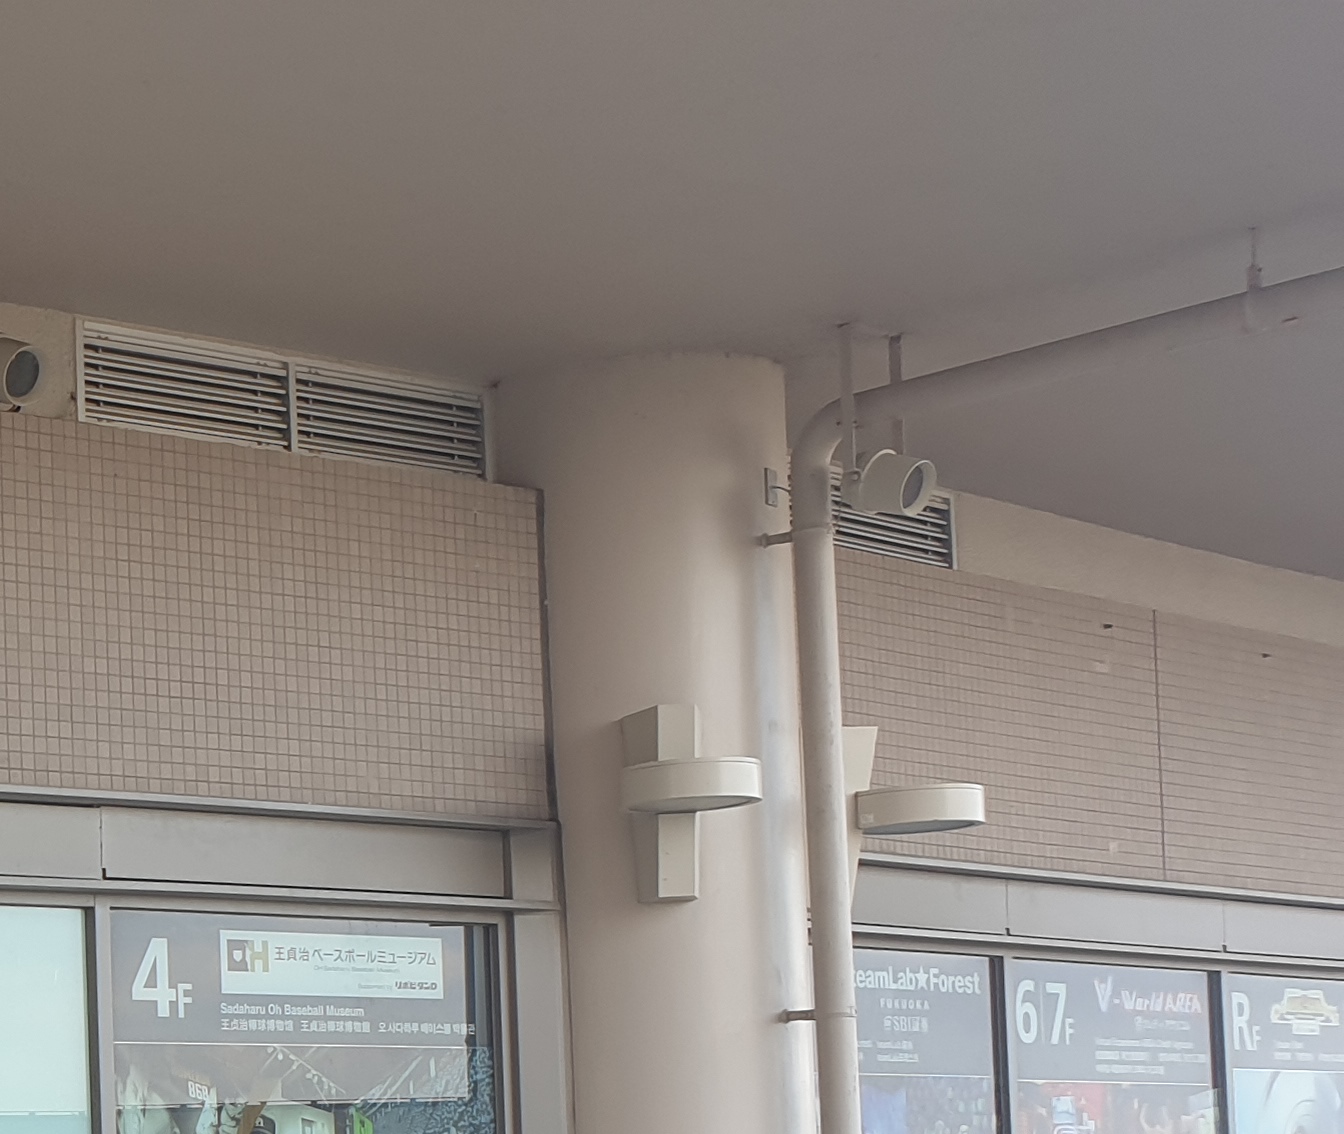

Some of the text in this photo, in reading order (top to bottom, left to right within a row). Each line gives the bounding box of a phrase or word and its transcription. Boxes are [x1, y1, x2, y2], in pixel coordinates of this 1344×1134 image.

[929, 968, 981, 994] Forest
[220, 1002, 364, 1017] Sadaharu Oh Baseball Museum
[880, 998, 930, 1010] FUKUOKA
